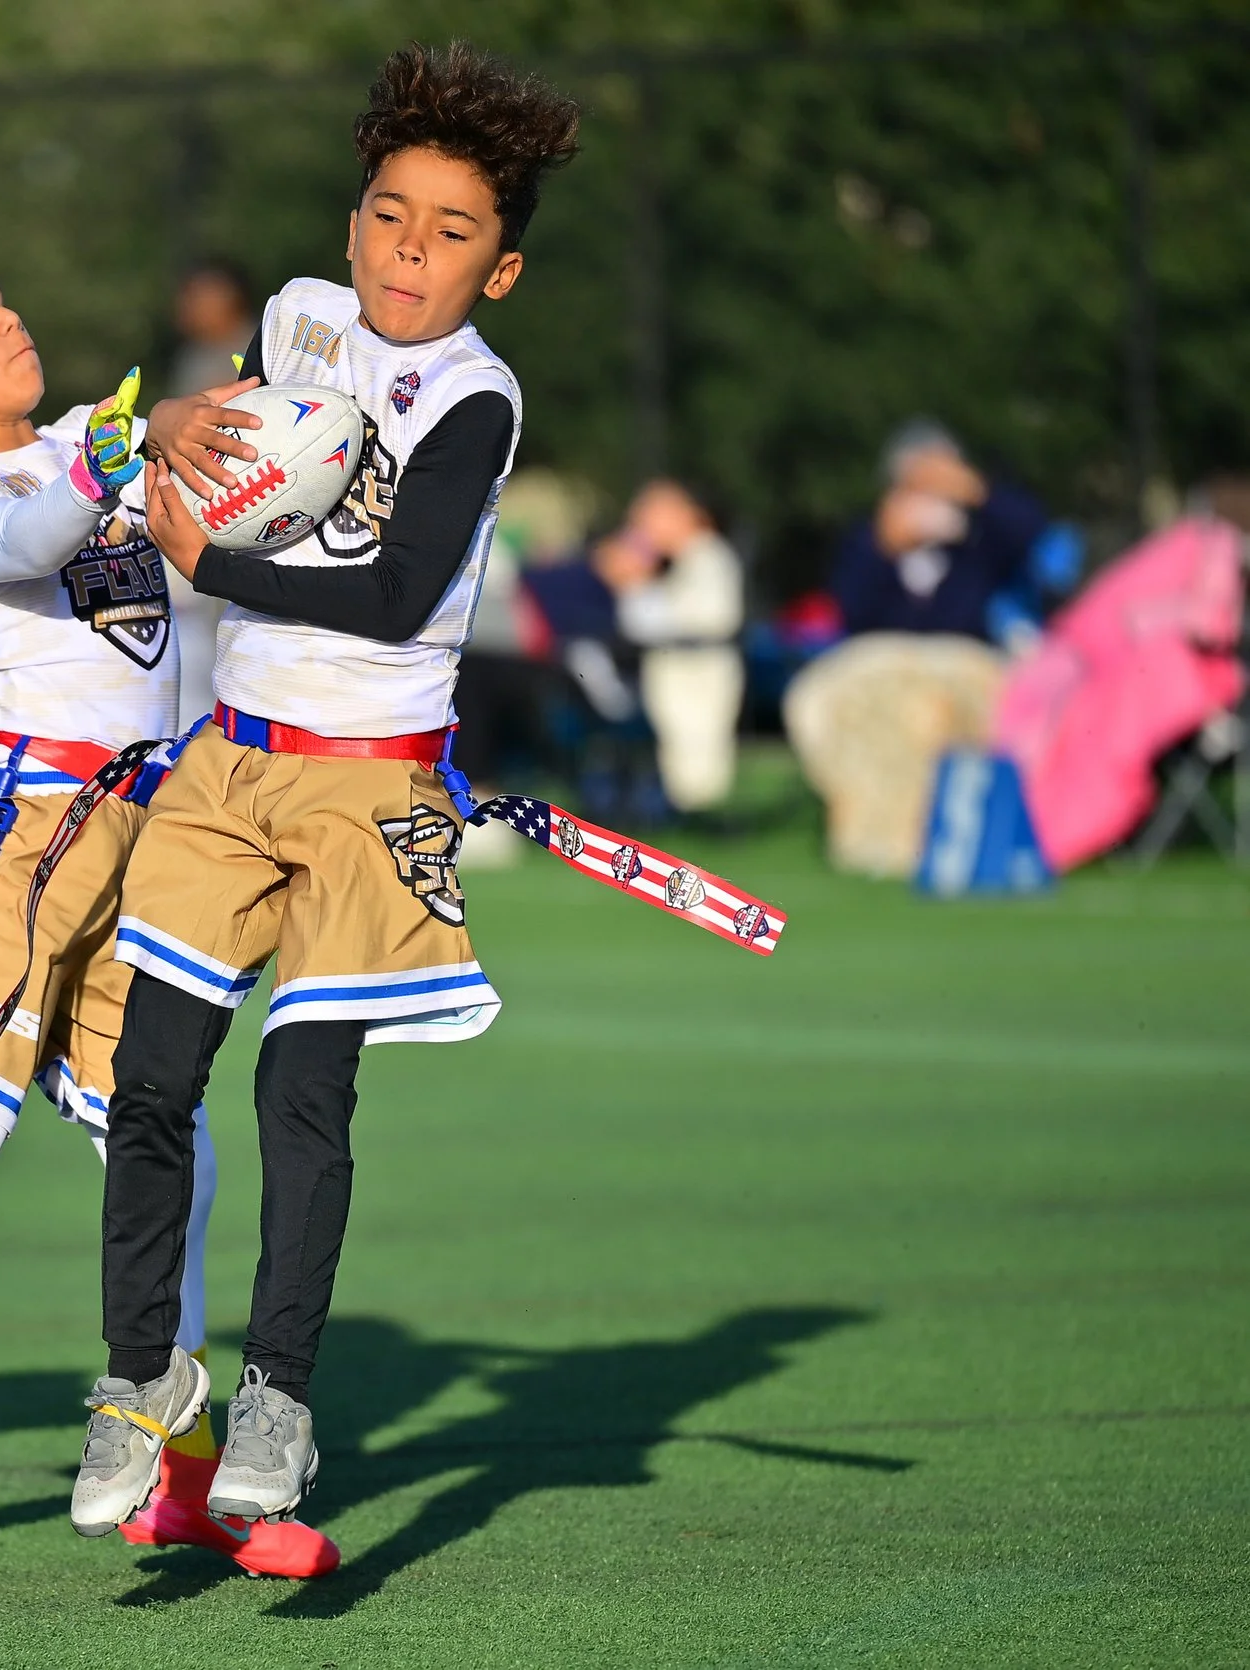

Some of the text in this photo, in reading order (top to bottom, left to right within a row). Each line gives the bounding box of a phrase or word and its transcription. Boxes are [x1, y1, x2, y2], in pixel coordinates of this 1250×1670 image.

[66, 548, 166, 608] FLAG
[101, 604, 144, 621] FOOTBALL
[672, 869, 699, 911] FLAG
[738, 904, 761, 940] FLAG
